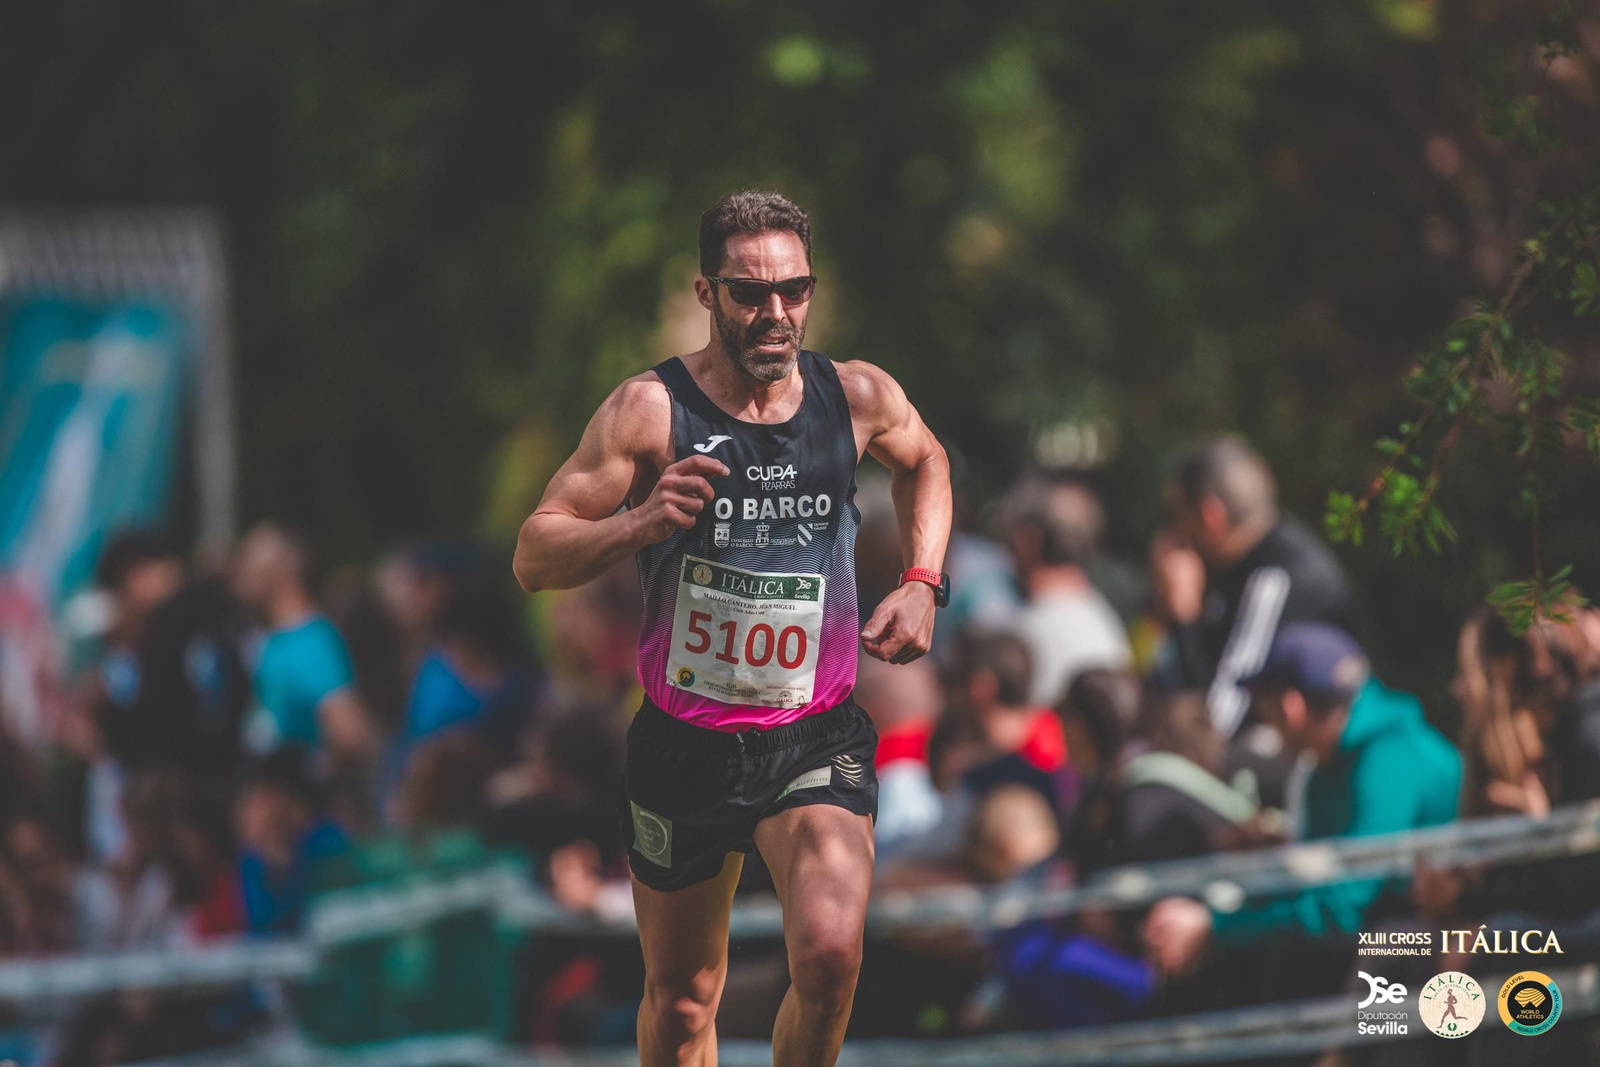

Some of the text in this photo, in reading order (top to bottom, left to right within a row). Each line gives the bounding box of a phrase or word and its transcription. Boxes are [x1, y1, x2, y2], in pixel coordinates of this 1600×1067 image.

[761, 480, 796, 490] PIZARRAS
[715, 494, 832, 520] O BARCO
[721, 572, 785, 595] ITÁLICA
[685, 610, 807, 670] 5100
